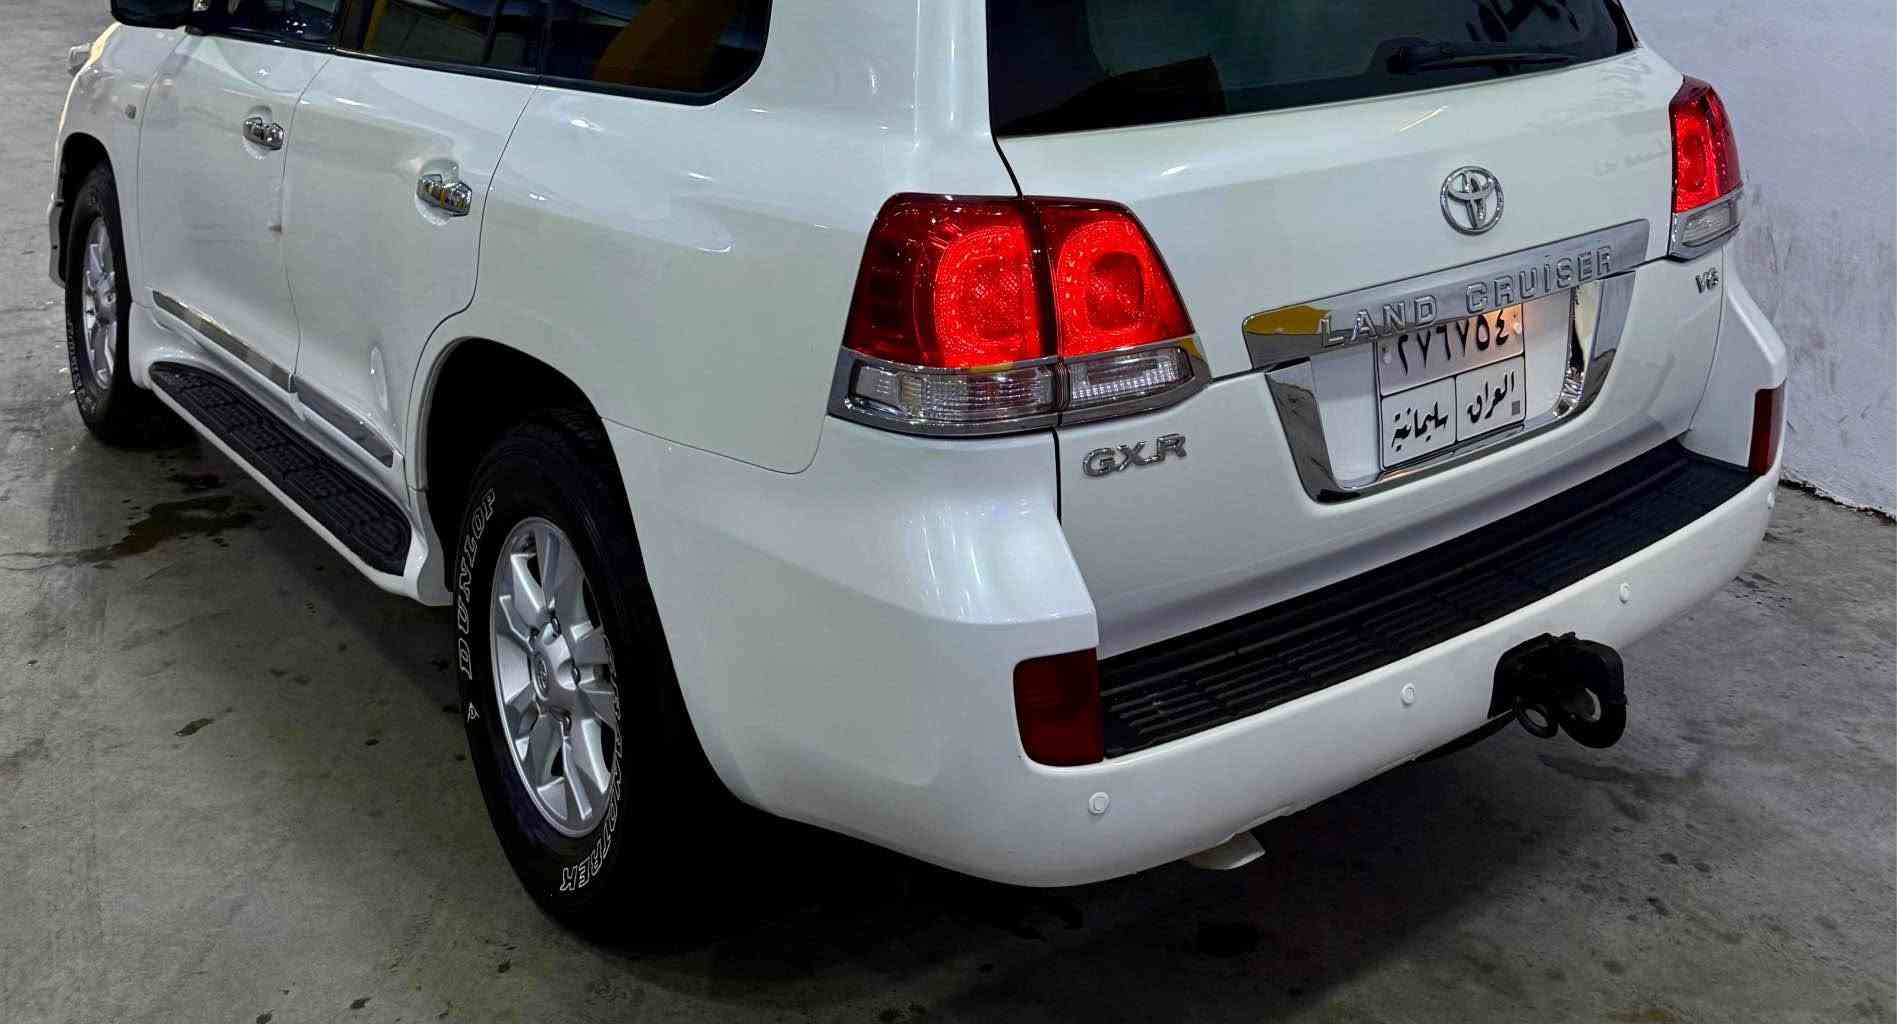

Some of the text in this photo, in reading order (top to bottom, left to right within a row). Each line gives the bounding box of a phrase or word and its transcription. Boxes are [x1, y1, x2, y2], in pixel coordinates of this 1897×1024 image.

[1319, 245, 1614, 349] LAND CRUISER
[1467, 371, 1515, 424] العراق
[1083, 433, 1187, 477] GXR
[457, 487, 496, 681] DUNLOP
